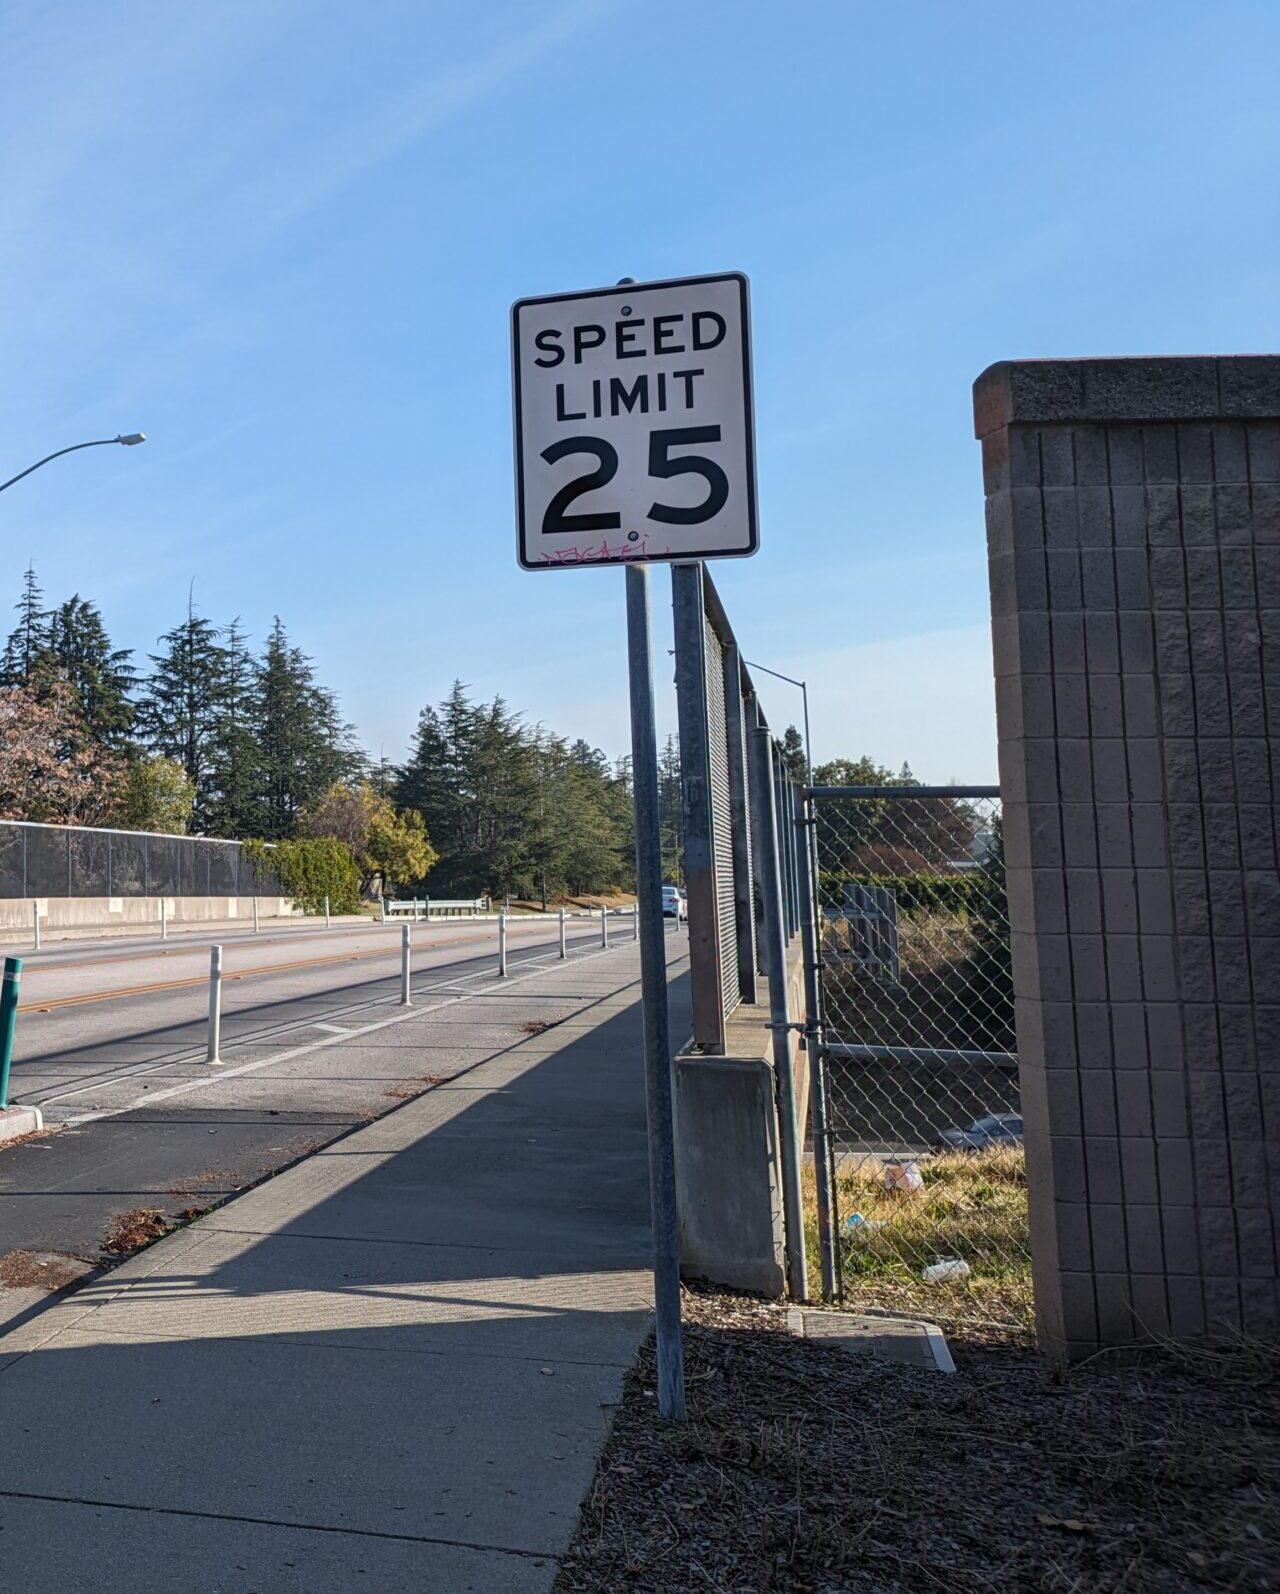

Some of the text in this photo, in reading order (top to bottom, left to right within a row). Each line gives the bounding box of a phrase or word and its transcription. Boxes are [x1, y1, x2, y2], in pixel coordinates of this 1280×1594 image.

[533, 310, 727, 369] SPEED
[555, 368, 705, 422] LIMIT
[539, 424, 730, 535] 25
